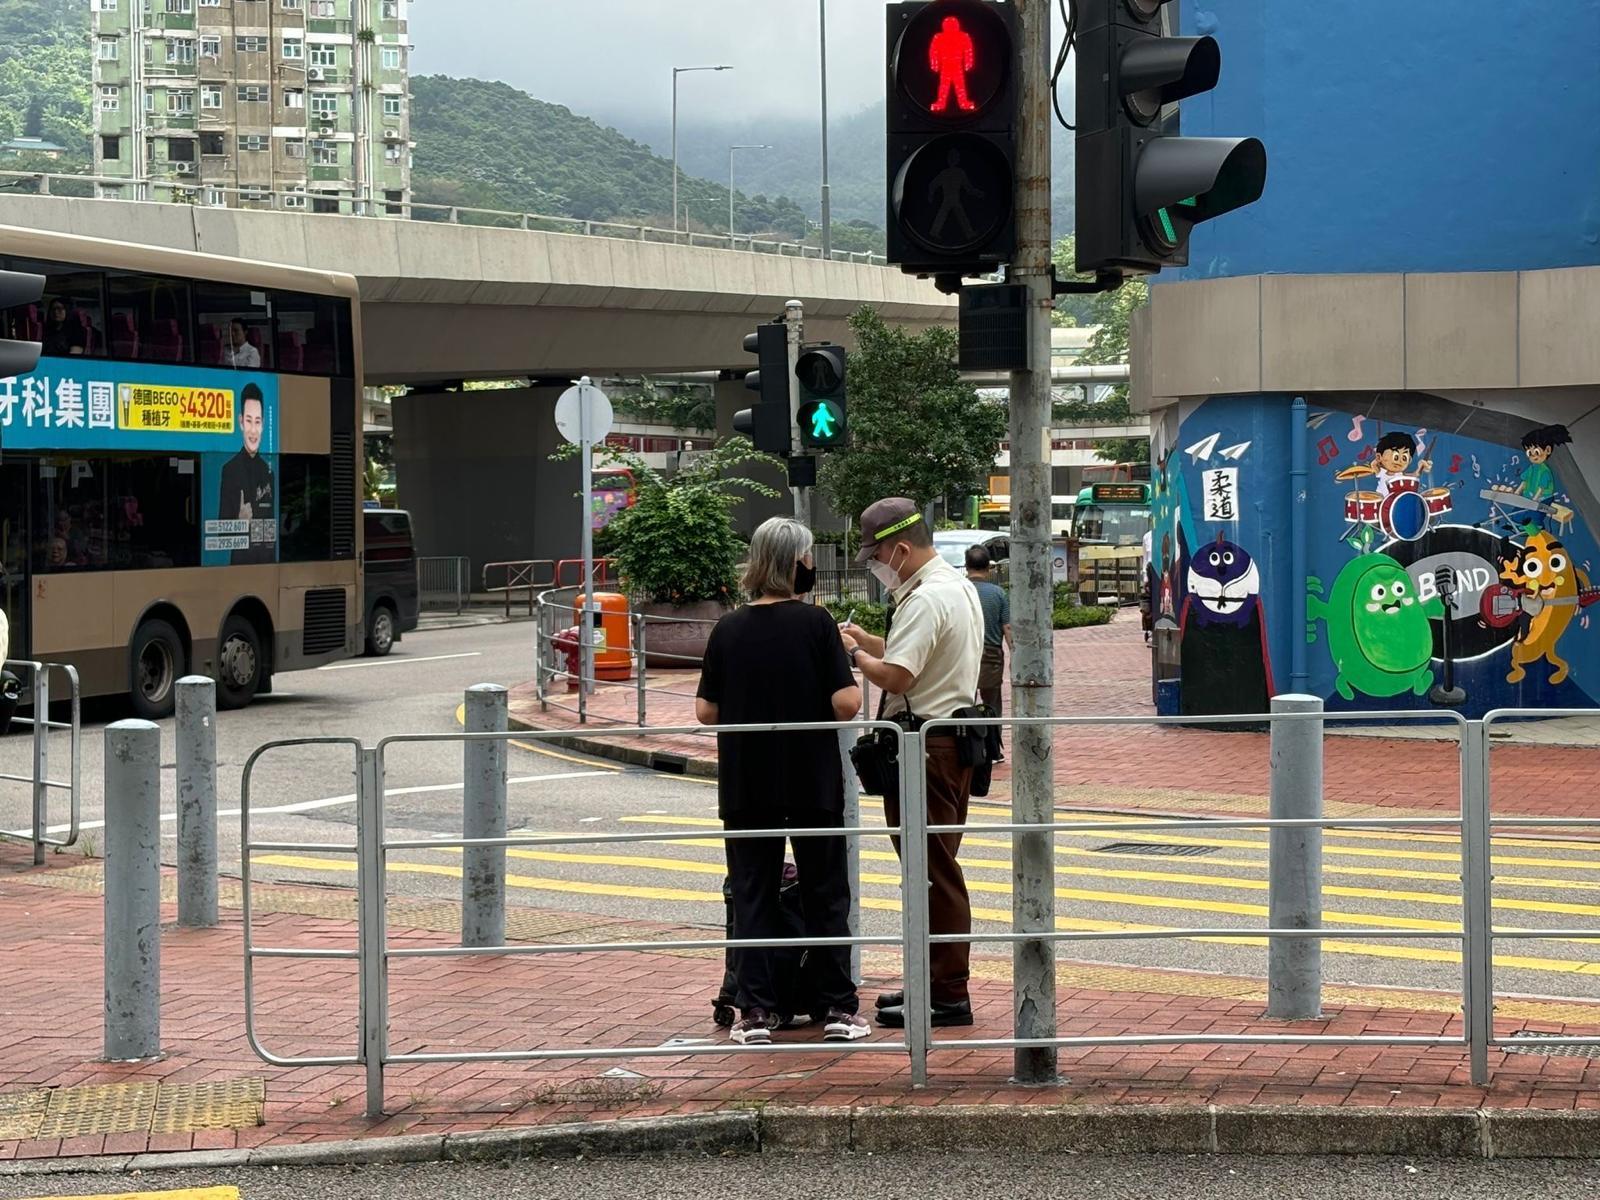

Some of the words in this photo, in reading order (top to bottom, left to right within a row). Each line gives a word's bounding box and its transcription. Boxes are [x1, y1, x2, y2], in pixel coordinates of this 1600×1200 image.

[0, 376, 115, 430] 牙科集團
[142, 409, 170, 427] 種植牙
[179, 390, 225, 419] $4320
[1210, 470, 1235, 519] 柔道
[1417, 567, 1490, 603] BND
